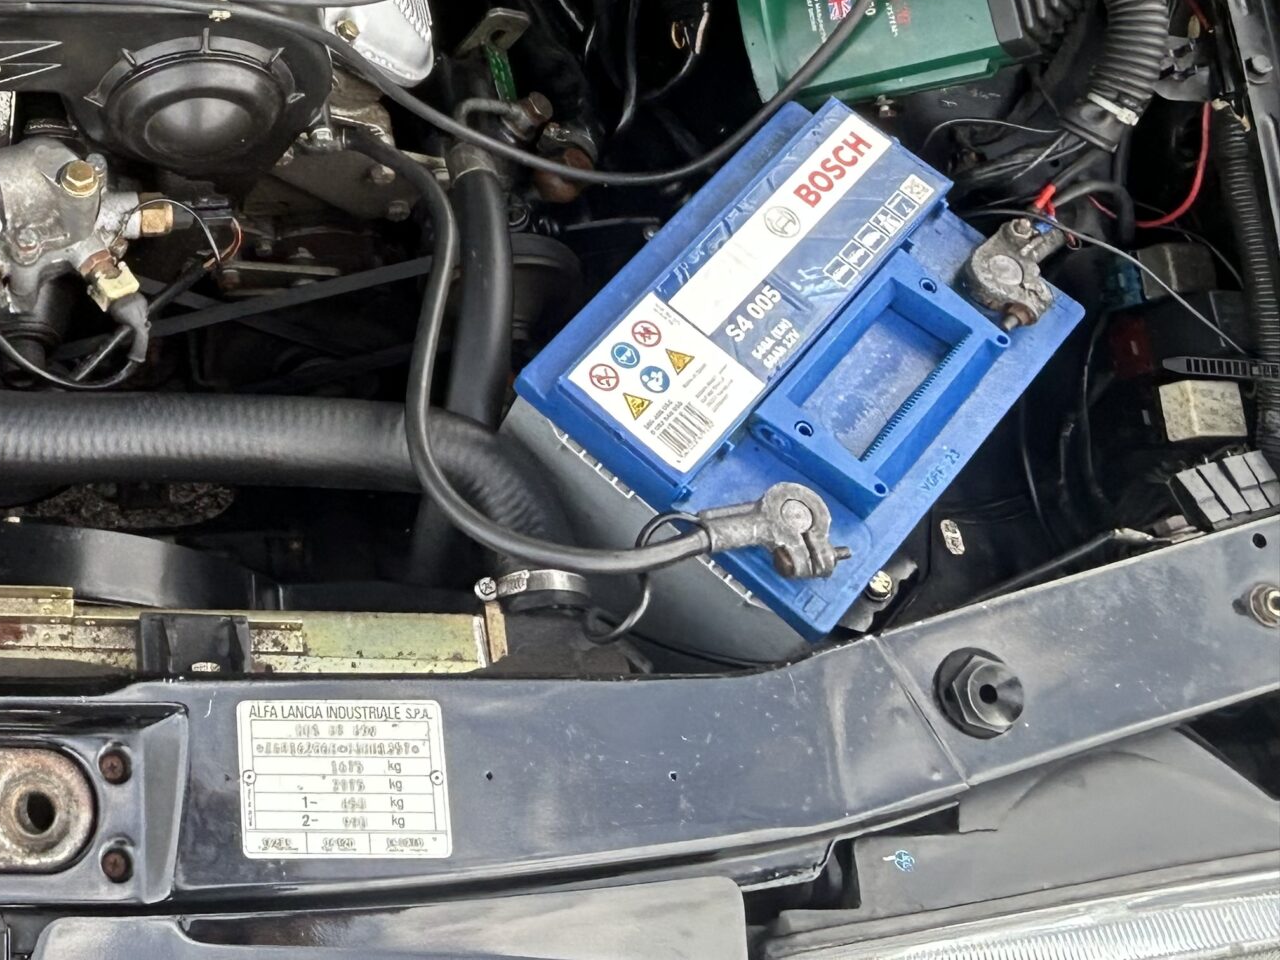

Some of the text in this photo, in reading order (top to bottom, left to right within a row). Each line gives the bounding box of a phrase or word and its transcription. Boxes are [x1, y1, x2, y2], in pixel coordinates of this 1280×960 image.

[793, 131, 873, 208] BOSCH
[725, 285, 781, 342] S4 005
[249, 705, 278, 719] ALFA
[281, 705, 323, 719] LANCIA
[326, 706, 400, 720] INDUSTRIALE
[388, 760, 402, 773] kg
[389, 778, 403, 792] kg
[390, 796, 404, 810] kg
[391, 815, 405, 828] kg
